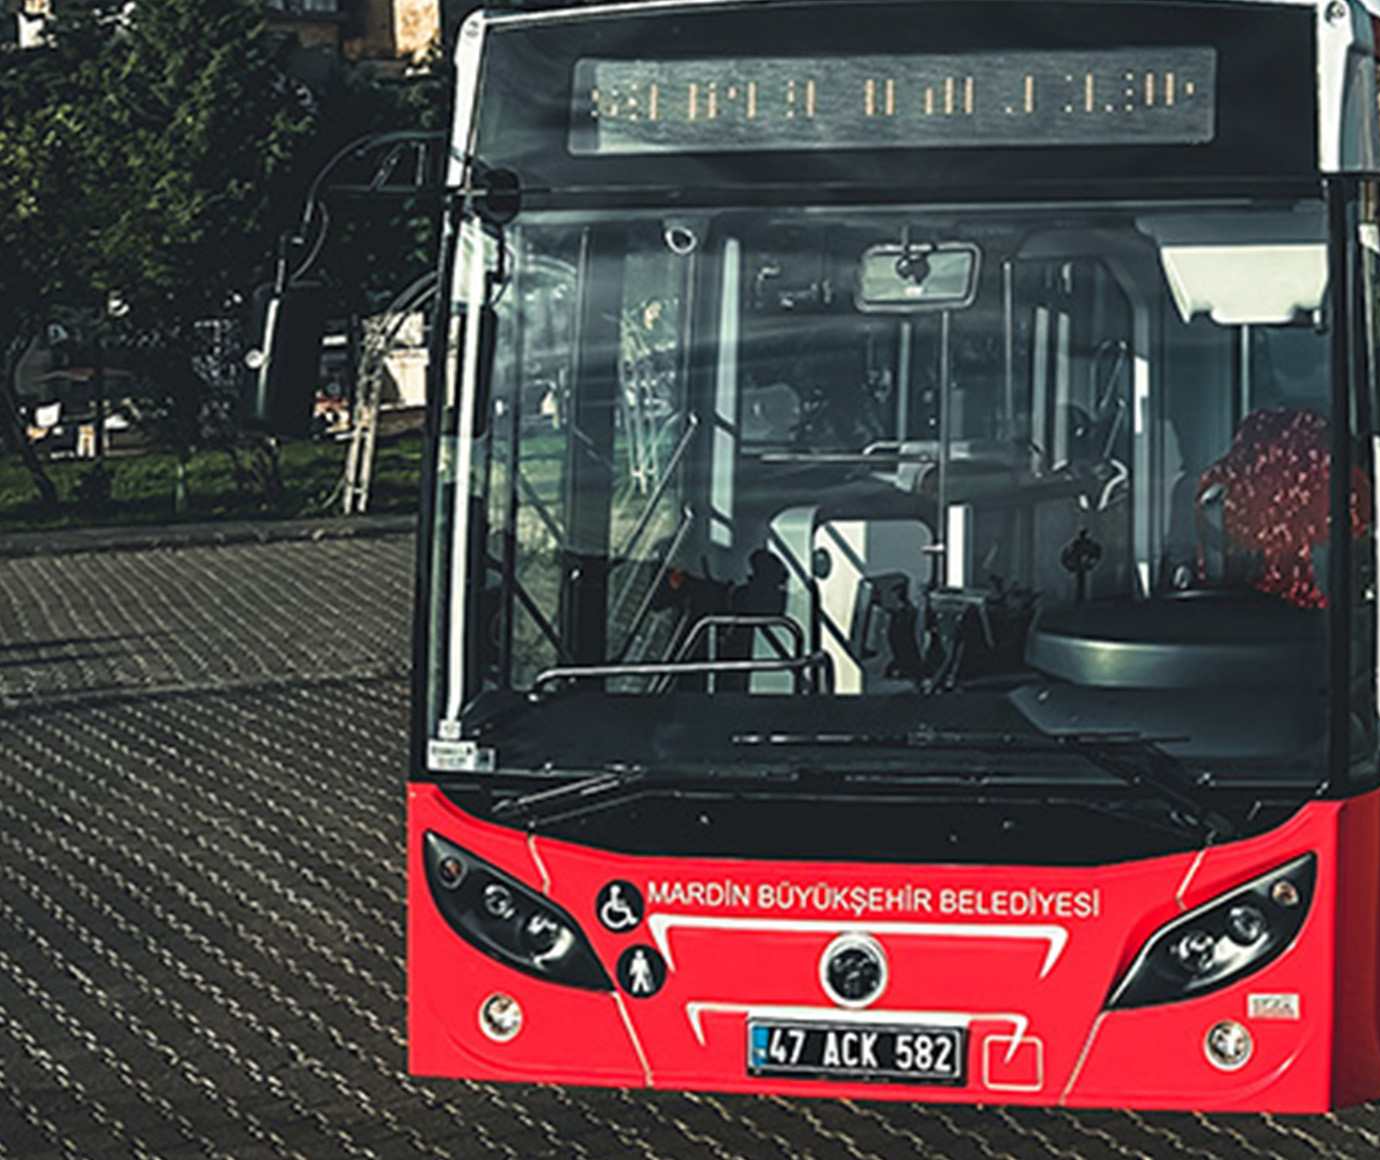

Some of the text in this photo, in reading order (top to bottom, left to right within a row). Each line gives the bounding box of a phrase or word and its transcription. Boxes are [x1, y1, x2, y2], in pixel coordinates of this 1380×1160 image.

[648, 879, 1100, 917] MARDİN BÜYÜKŞEHİR BELEDİYESİ
[769, 1028, 952, 1072] 47 ACK 582
